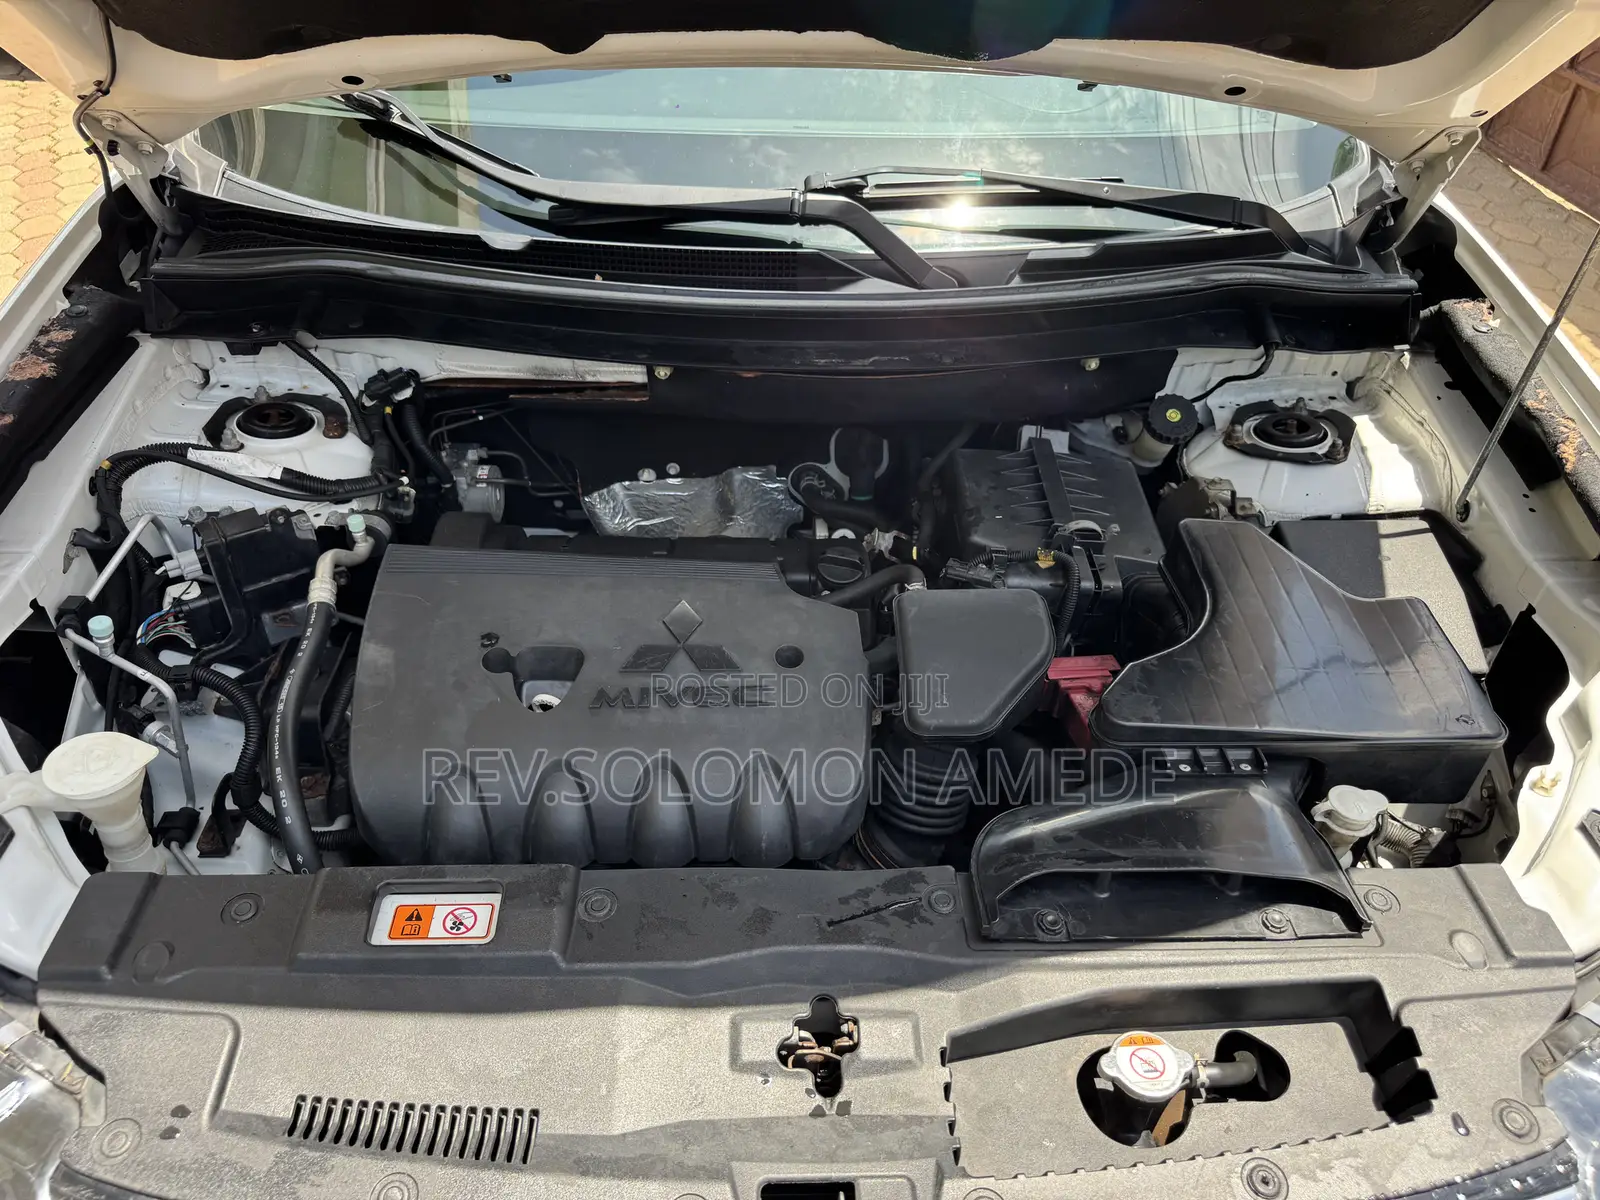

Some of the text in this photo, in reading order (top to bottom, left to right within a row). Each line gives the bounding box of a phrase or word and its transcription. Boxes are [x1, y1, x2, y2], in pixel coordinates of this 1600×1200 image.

[275, 767, 283, 783] EK
[279, 790, 288, 808] 20
[285, 816, 292, 825] 2
